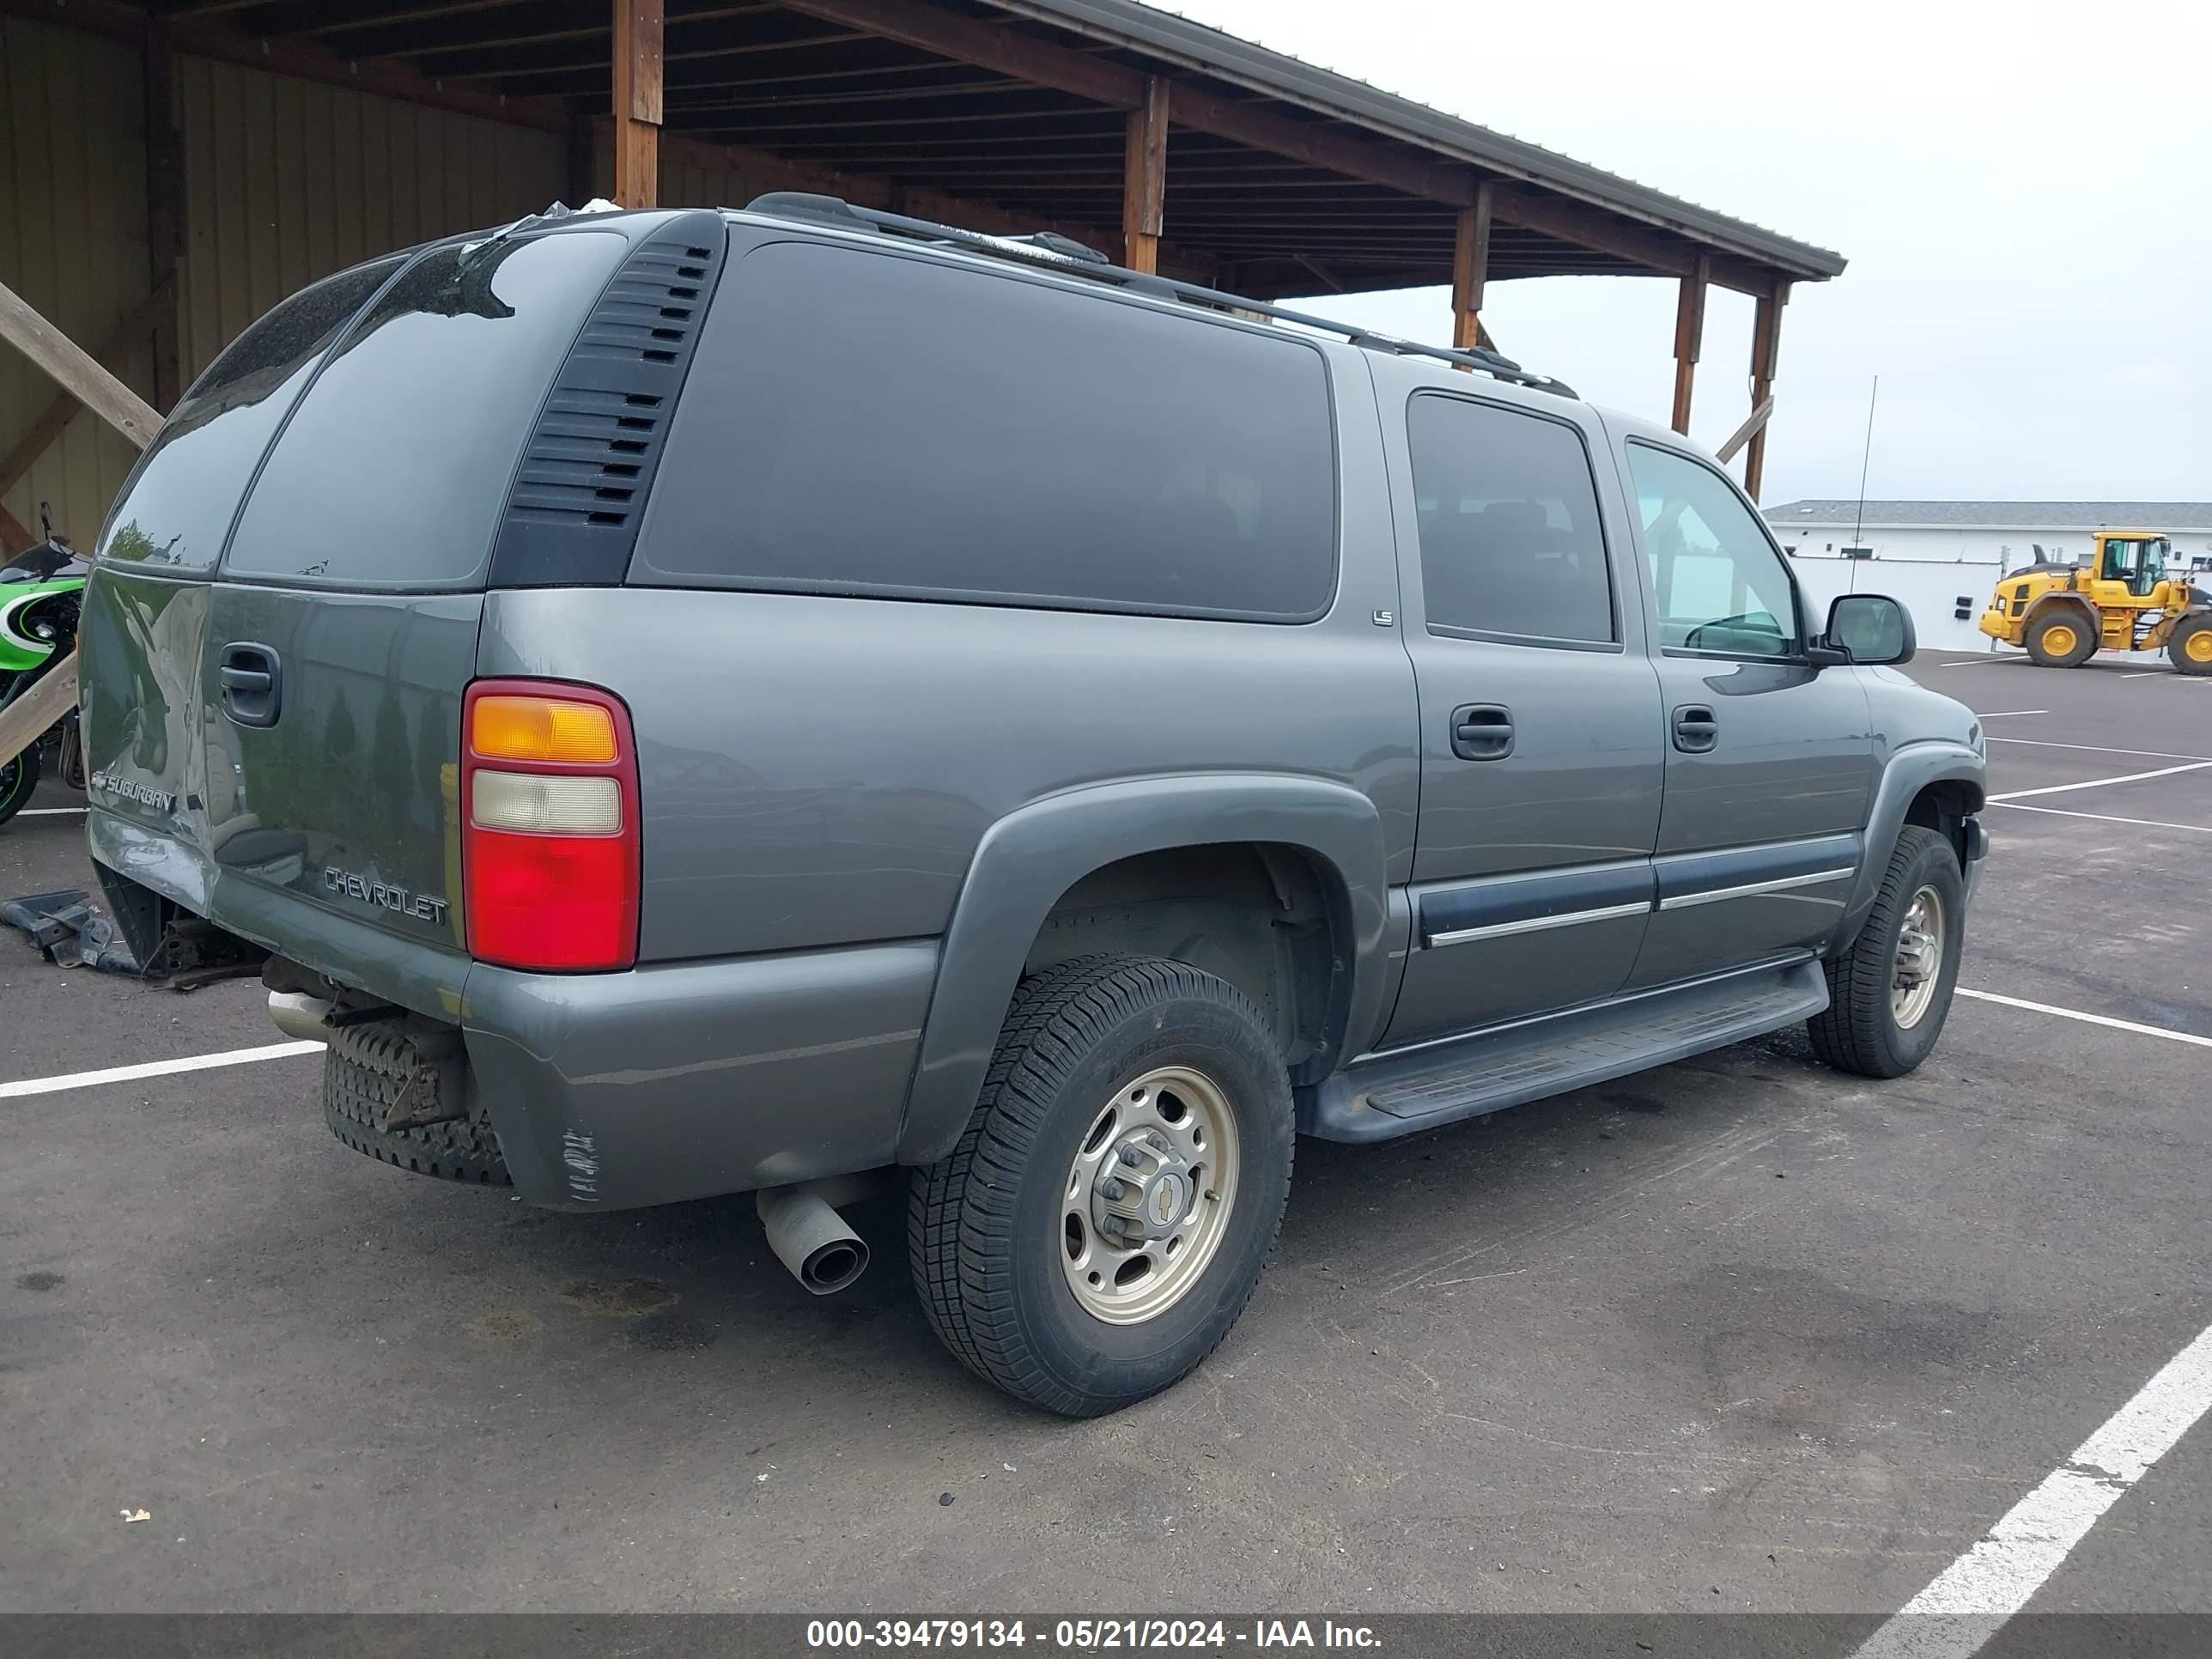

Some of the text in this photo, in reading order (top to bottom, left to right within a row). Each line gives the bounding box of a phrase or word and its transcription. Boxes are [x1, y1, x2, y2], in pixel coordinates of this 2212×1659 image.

[1373, 611, 1393, 623] LS
[106, 776, 173, 811] SUBURBAN
[324, 868, 447, 924] CHEVROLET
